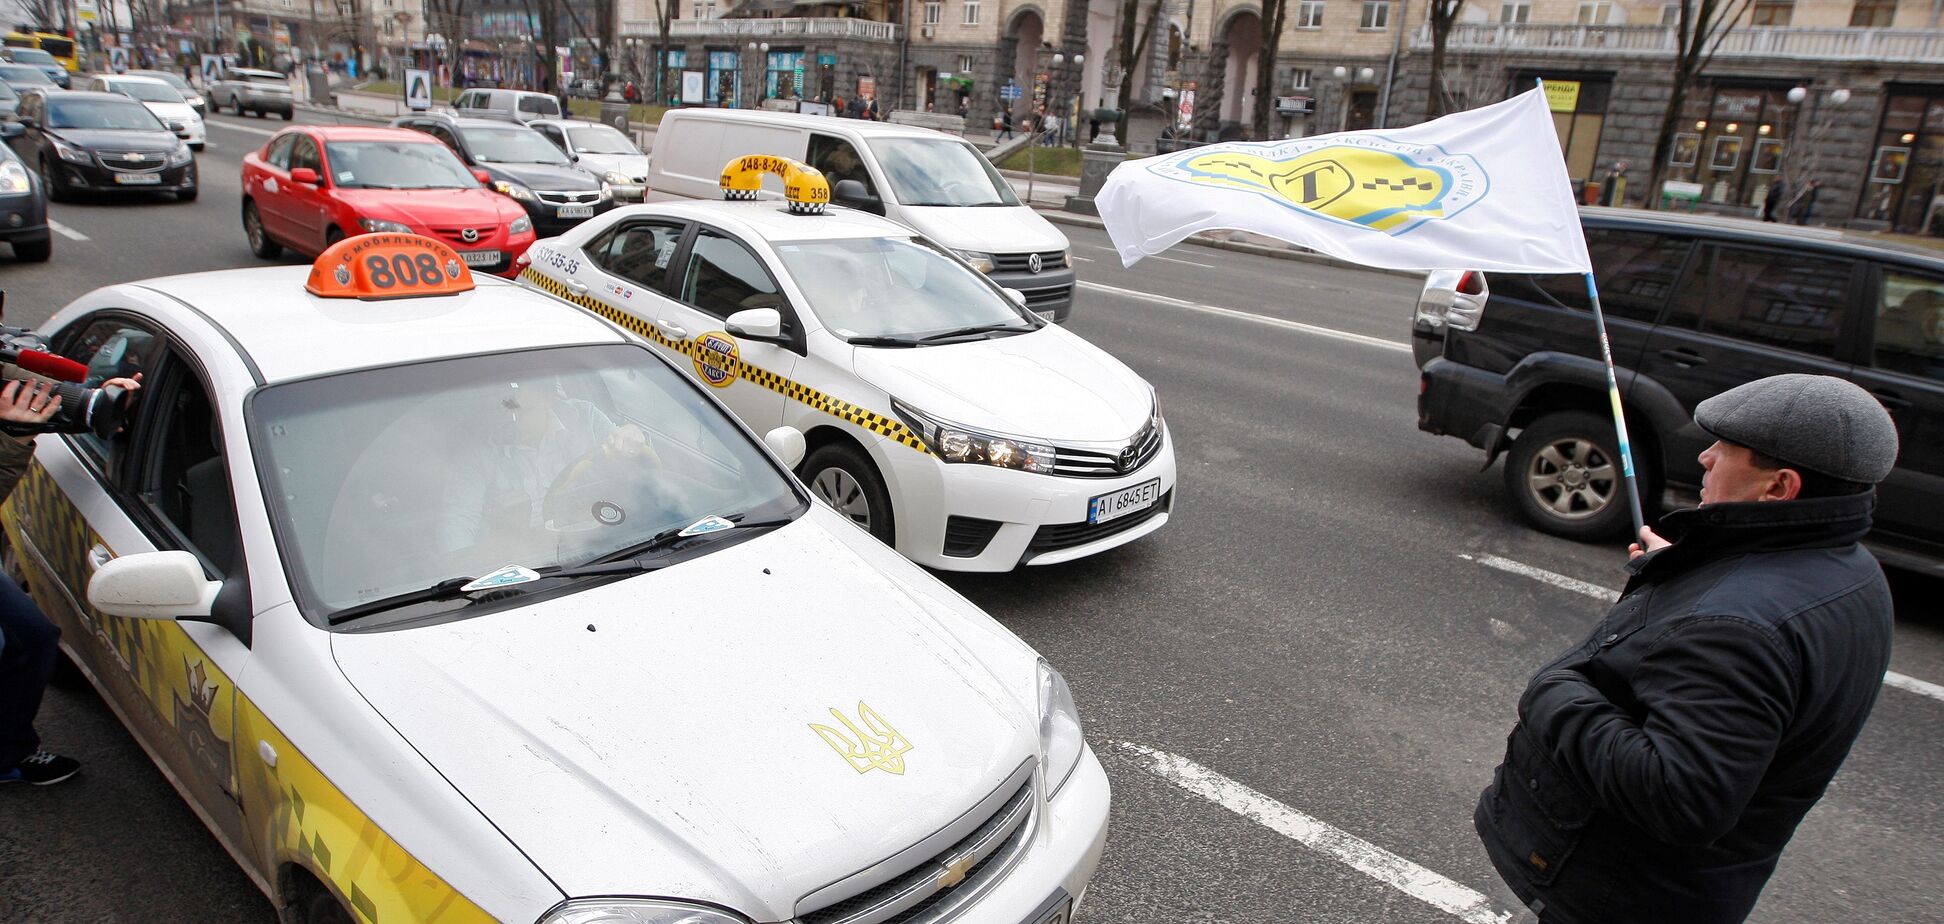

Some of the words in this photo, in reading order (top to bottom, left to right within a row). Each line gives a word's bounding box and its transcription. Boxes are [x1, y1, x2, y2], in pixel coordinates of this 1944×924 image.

[740, 158, 788, 177] 248-8-248
[810, 187, 828, 199] 358
[467, 253, 486, 262] 0323
[367, 252, 444, 289] 808
[1098, 497, 1113, 516] AI
[1116, 488, 1140, 509] 6845
[1142, 483, 1157, 501] ET
